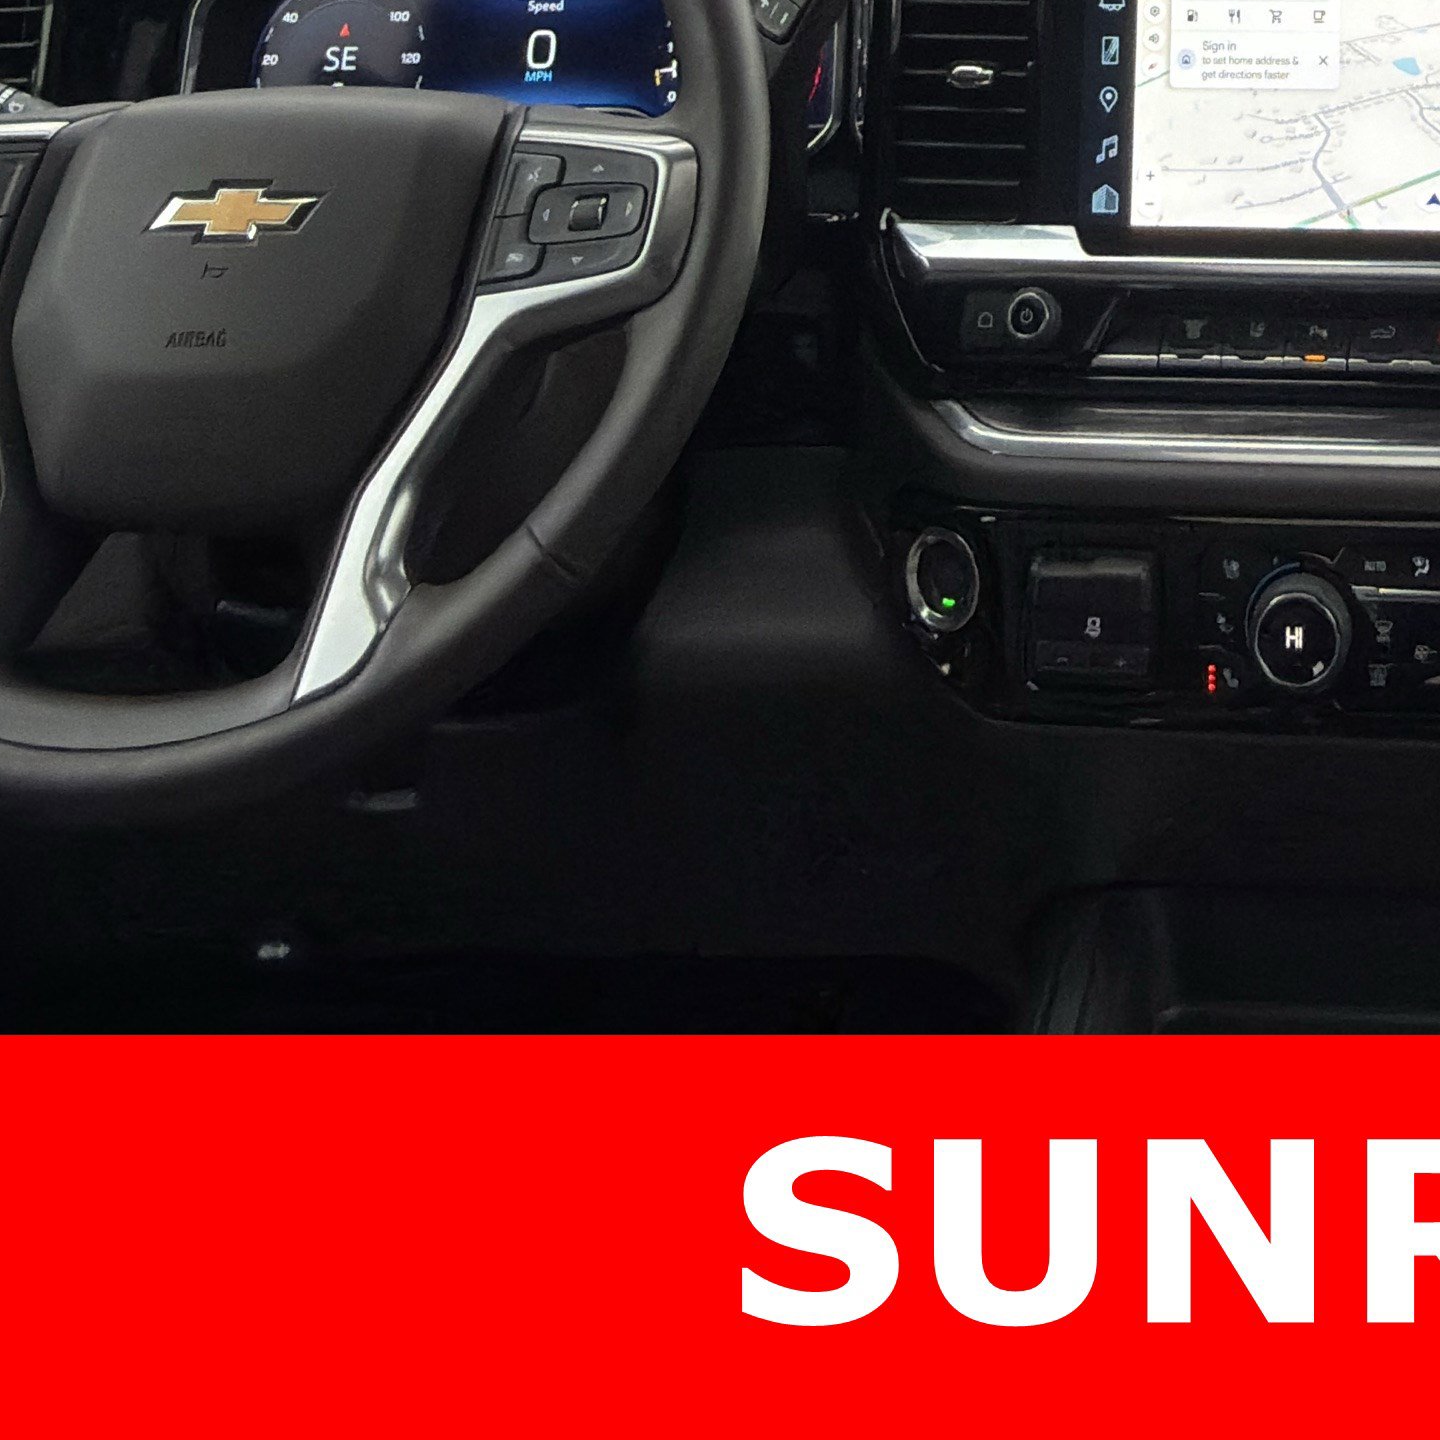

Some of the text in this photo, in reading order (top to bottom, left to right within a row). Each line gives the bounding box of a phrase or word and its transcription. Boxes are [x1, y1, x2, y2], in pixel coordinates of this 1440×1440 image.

[527, 0, 565, 15] Speed
[282, 12, 299, 24] 40
[389, 11, 410, 23] 100
[526, 29, 557, 69] 0
[1202, 40, 1237, 54] Sign in
[261, 54, 279, 66] 20
[323, 46, 359, 72] SE
[401, 53, 421, 65] 120
[1202, 55, 1299, 65] to set home address &
[524, 70, 553, 82] MPH
[1201, 69, 1289, 80] get directions faster
[1284, 625, 1304, 651] HI
